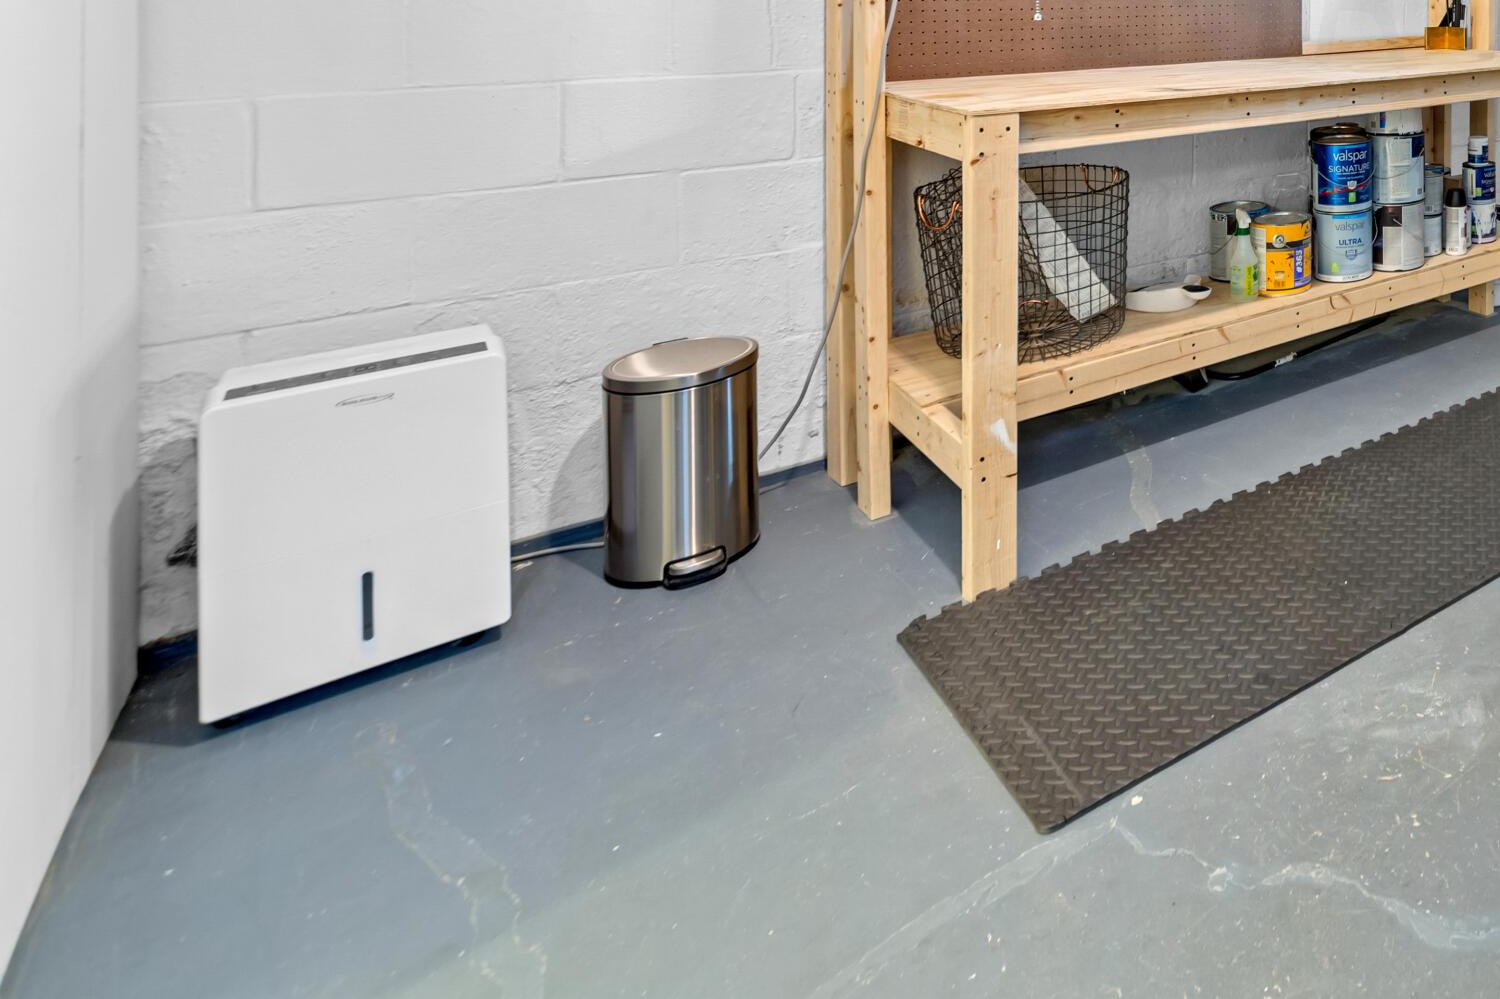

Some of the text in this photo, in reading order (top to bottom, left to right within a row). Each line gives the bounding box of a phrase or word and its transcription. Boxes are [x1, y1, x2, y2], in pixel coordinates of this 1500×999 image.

[1333, 149, 1367, 162] valspar
[1328, 162, 1370, 173] SIGNATURE
[1335, 220, 1365, 232] valspar
[1338, 238, 1362, 246] ULTRA
